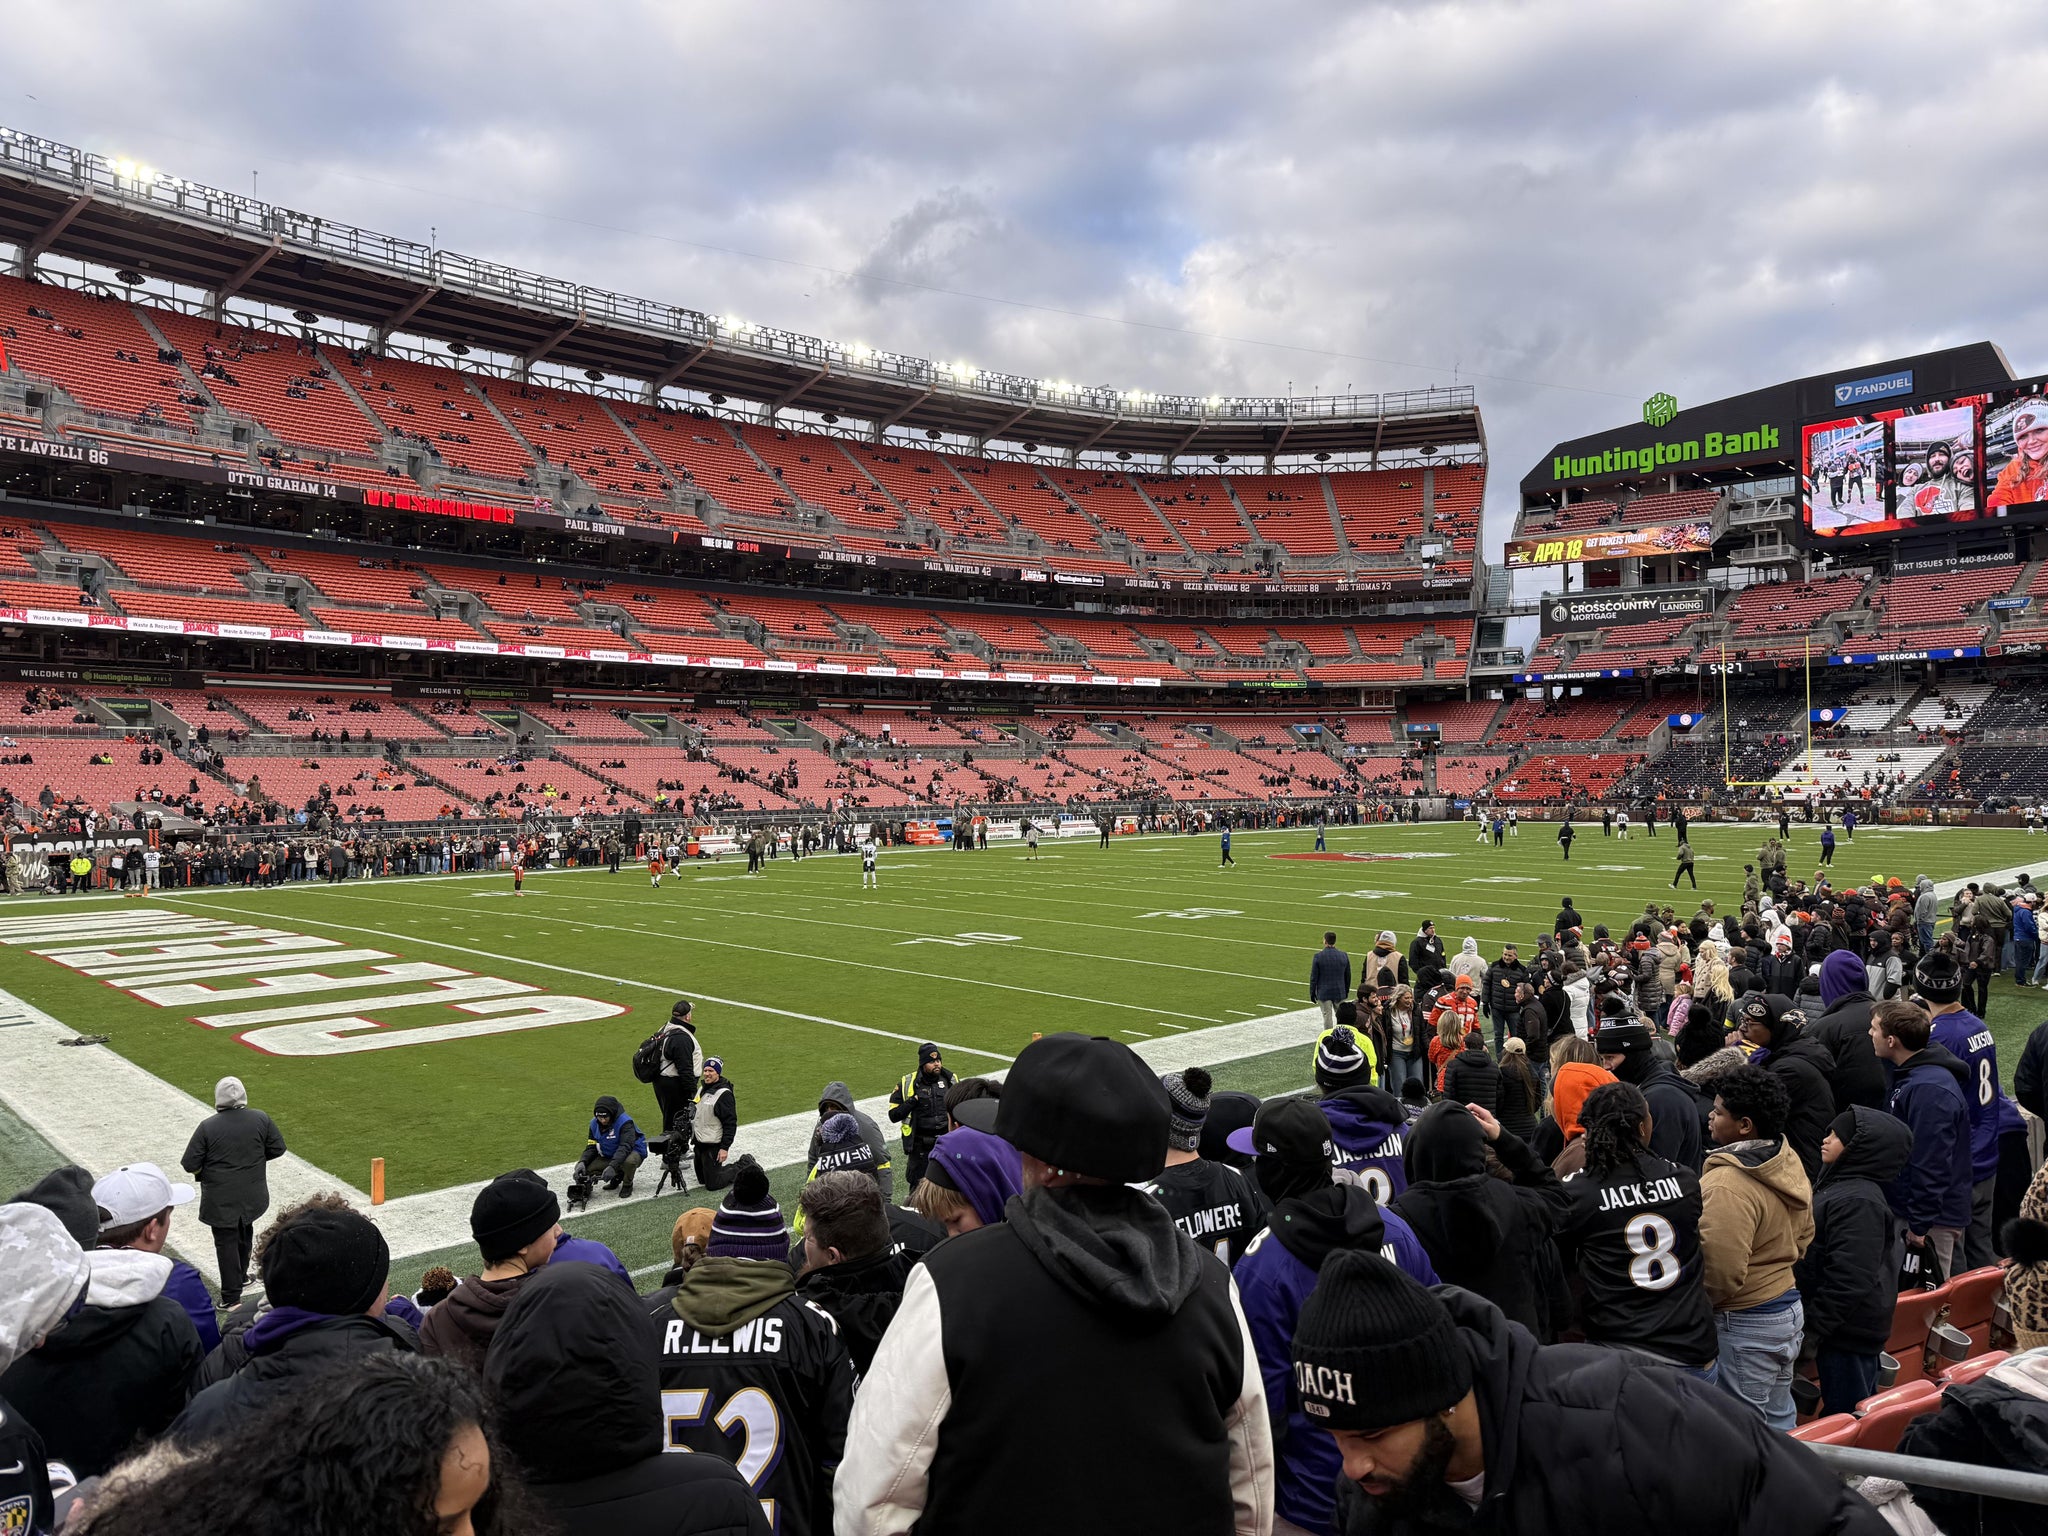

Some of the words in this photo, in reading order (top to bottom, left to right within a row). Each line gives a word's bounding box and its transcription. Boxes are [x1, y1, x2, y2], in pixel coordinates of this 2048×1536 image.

[1855, 378, 1912, 396] FANDUEL
[20, 439, 83, 460] LAVELLI
[88, 449, 108, 465] 86
[1553, 440, 1699, 480] Huntington
[1704, 424, 1779, 458] Bank
[228, 471, 263, 487] OTTO
[267, 478, 319, 495] GRAHAM
[324, 485, 337, 498] 14
[564, 518, 590, 532] PAUL
[592, 522, 625, 536] BROWN
[701, 537, 714, 548] TIME
[715, 539, 722, 548] OF
[723, 540, 734, 550] DAY
[750, 544, 759, 552] PM
[1586, 538, 1599, 547] GET
[1599, 535, 1624, 546] TICKETS
[1624, 533, 1648, 544] TODAY!
[1533, 542, 1564, 562] APR
[1566, 540, 1583, 560] 18
[818, 551, 834, 560] JIM
[836, 552, 863, 564] BROWN
[865, 556, 876, 566] 32
[1894, 562, 1913, 571] TEXT
[1916, 560, 1943, 569] ISSUES
[1945, 558, 1957, 566] TO
[1960, 553, 2014, 564] 440-824-6000
[924, 562, 943, 572] PAUL
[944, 564, 980, 575] WARFIELD
[981, 567, 992, 576] 42
[1125, 579, 1138, 587] LOU
[1139, 580, 1159, 589] GROZA
[1161, 581, 1171, 590] 76
[1184, 583, 1203, 591] OZZIE
[1204, 584, 1238, 592] NEWSOME
[1240, 584, 1250, 592] 82
[1265, 584, 1279, 592] MAC
[1281, 584, 1308, 592] SPEEDIE
[1309, 584, 1319, 592] 88
[1335, 583, 1349, 591] JOE
[1350, 582, 1380, 591] THOMAS
[1382, 582, 1392, 590] 73
[1570, 600, 1657, 614] CROSSCOUNTRY
[1662, 602, 1701, 611] LANDING
[57, 616, 83, 624] Recycling
[1571, 612, 1616, 621] MORTGAGE
[154, 623, 178, 631] Recycling
[20, 669, 64, 678] WELCOME
[93, 673, 132, 682] Huntington
[1710, 663, 1742, 674] 54:27
[1967, 1030, 1994, 1053] JACKSON
[1978, 1058, 1993, 1106] 8
[1599, 1176, 1683, 1211] JACKSON
[1624, 1212, 1681, 1292] 8
